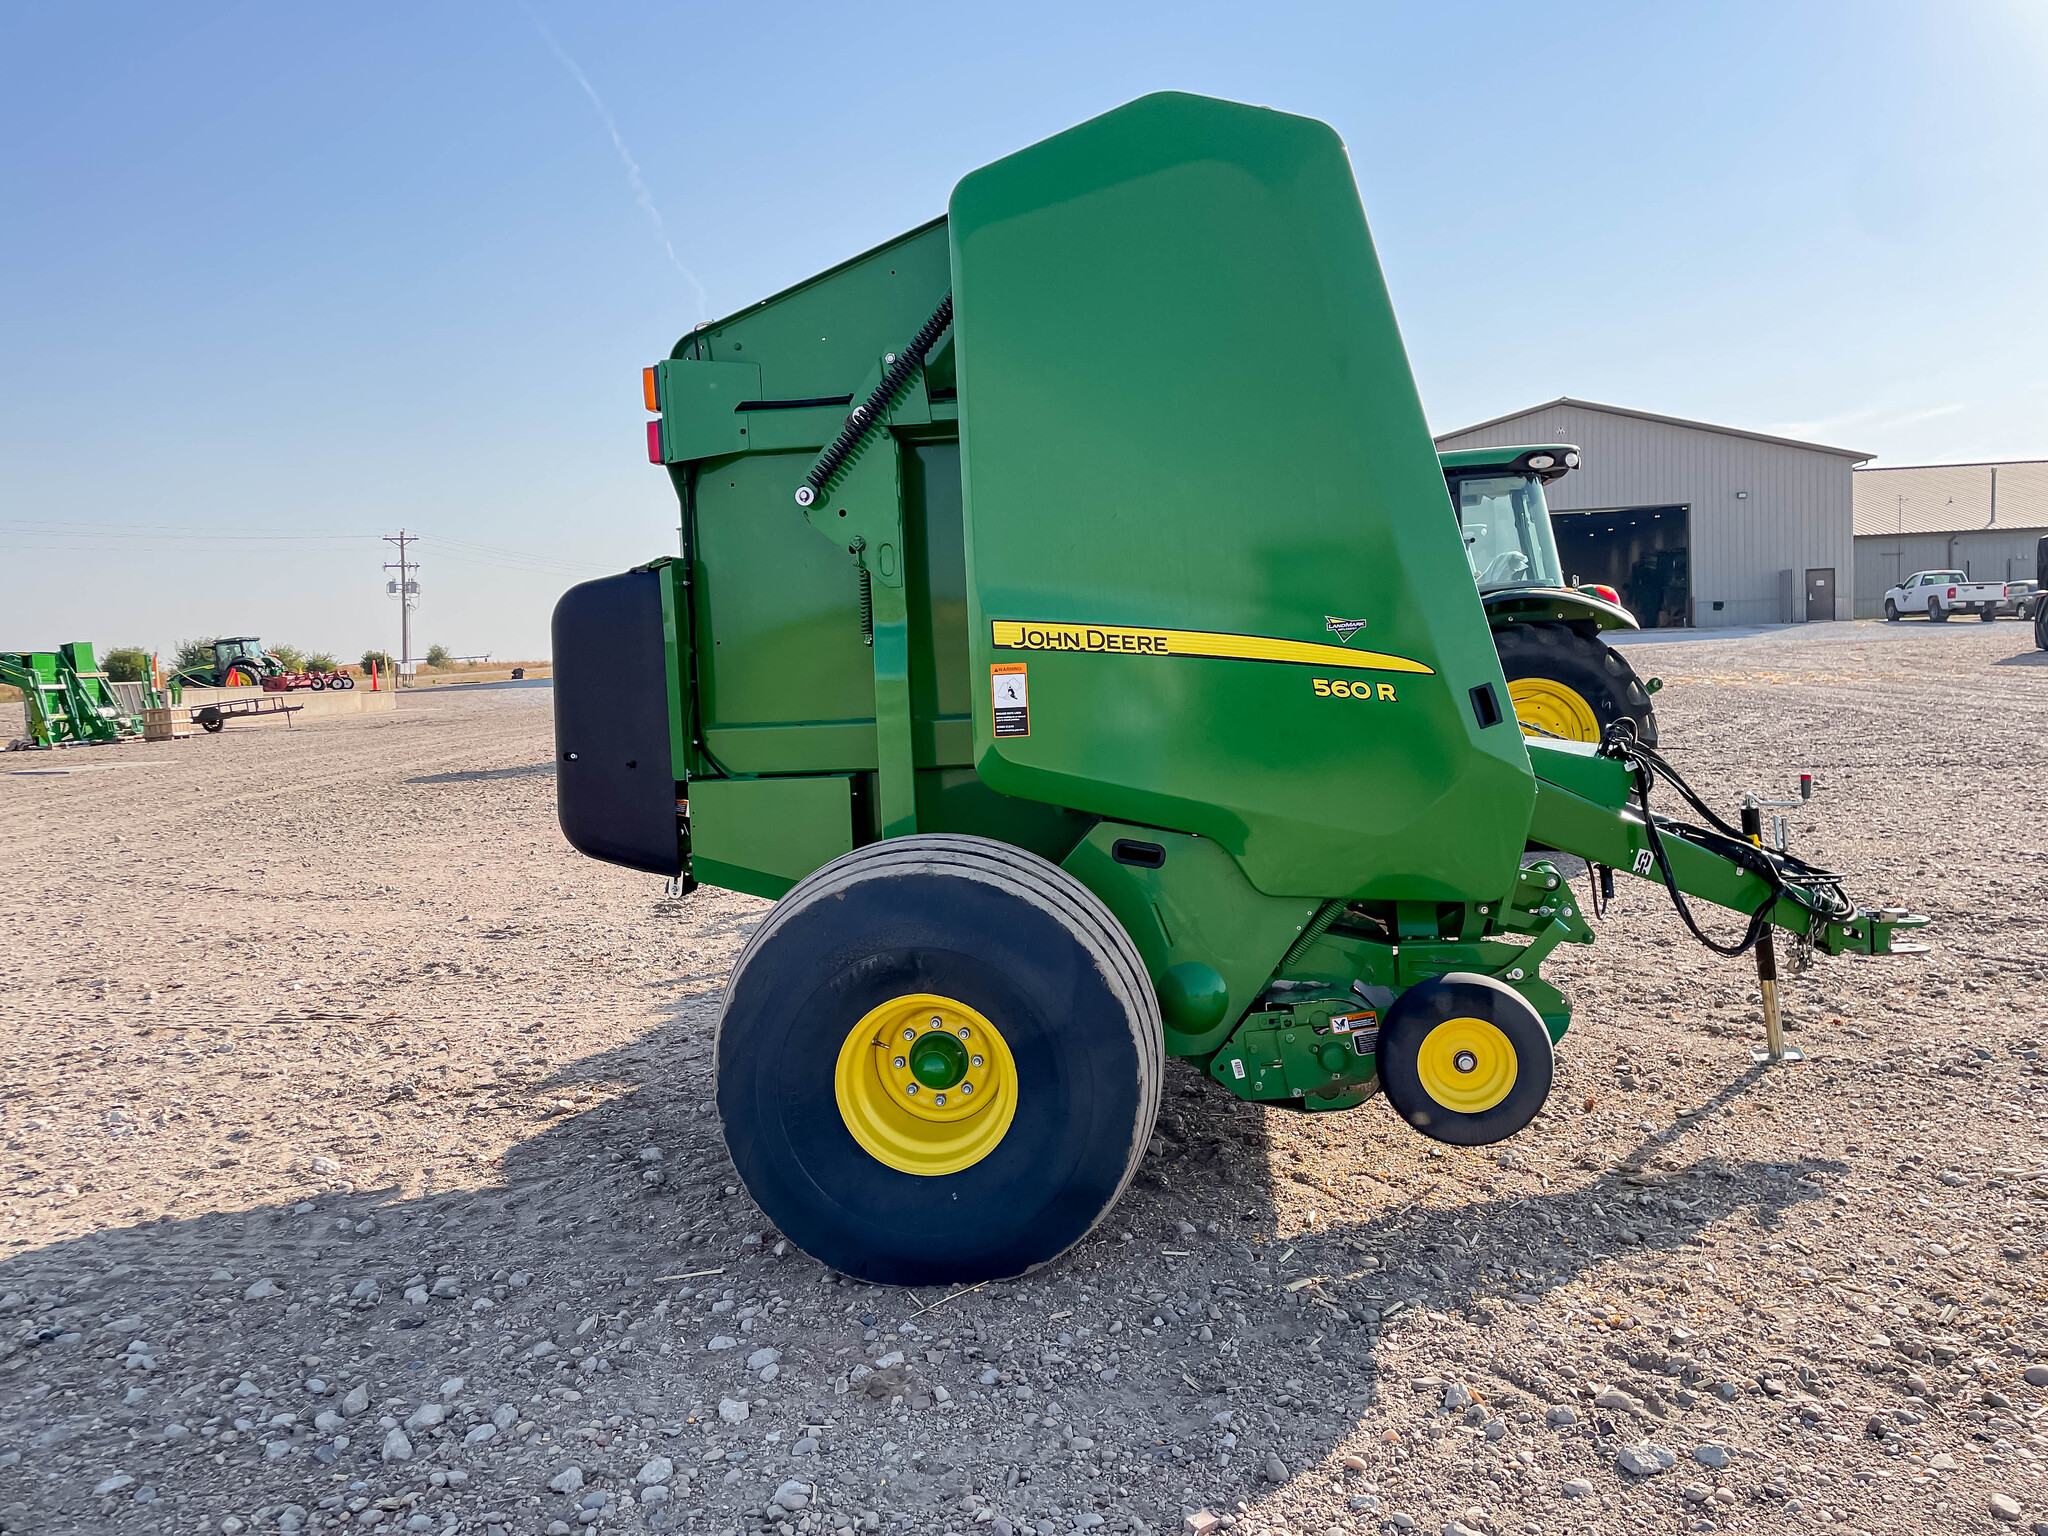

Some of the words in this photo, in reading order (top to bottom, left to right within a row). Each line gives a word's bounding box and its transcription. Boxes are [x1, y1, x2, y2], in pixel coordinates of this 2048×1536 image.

[1013, 627, 1080, 648] JOHN
[1086, 629, 1169, 651] DEERE
[1312, 678, 1372, 700] 560
[1376, 682, 1398, 702] R
